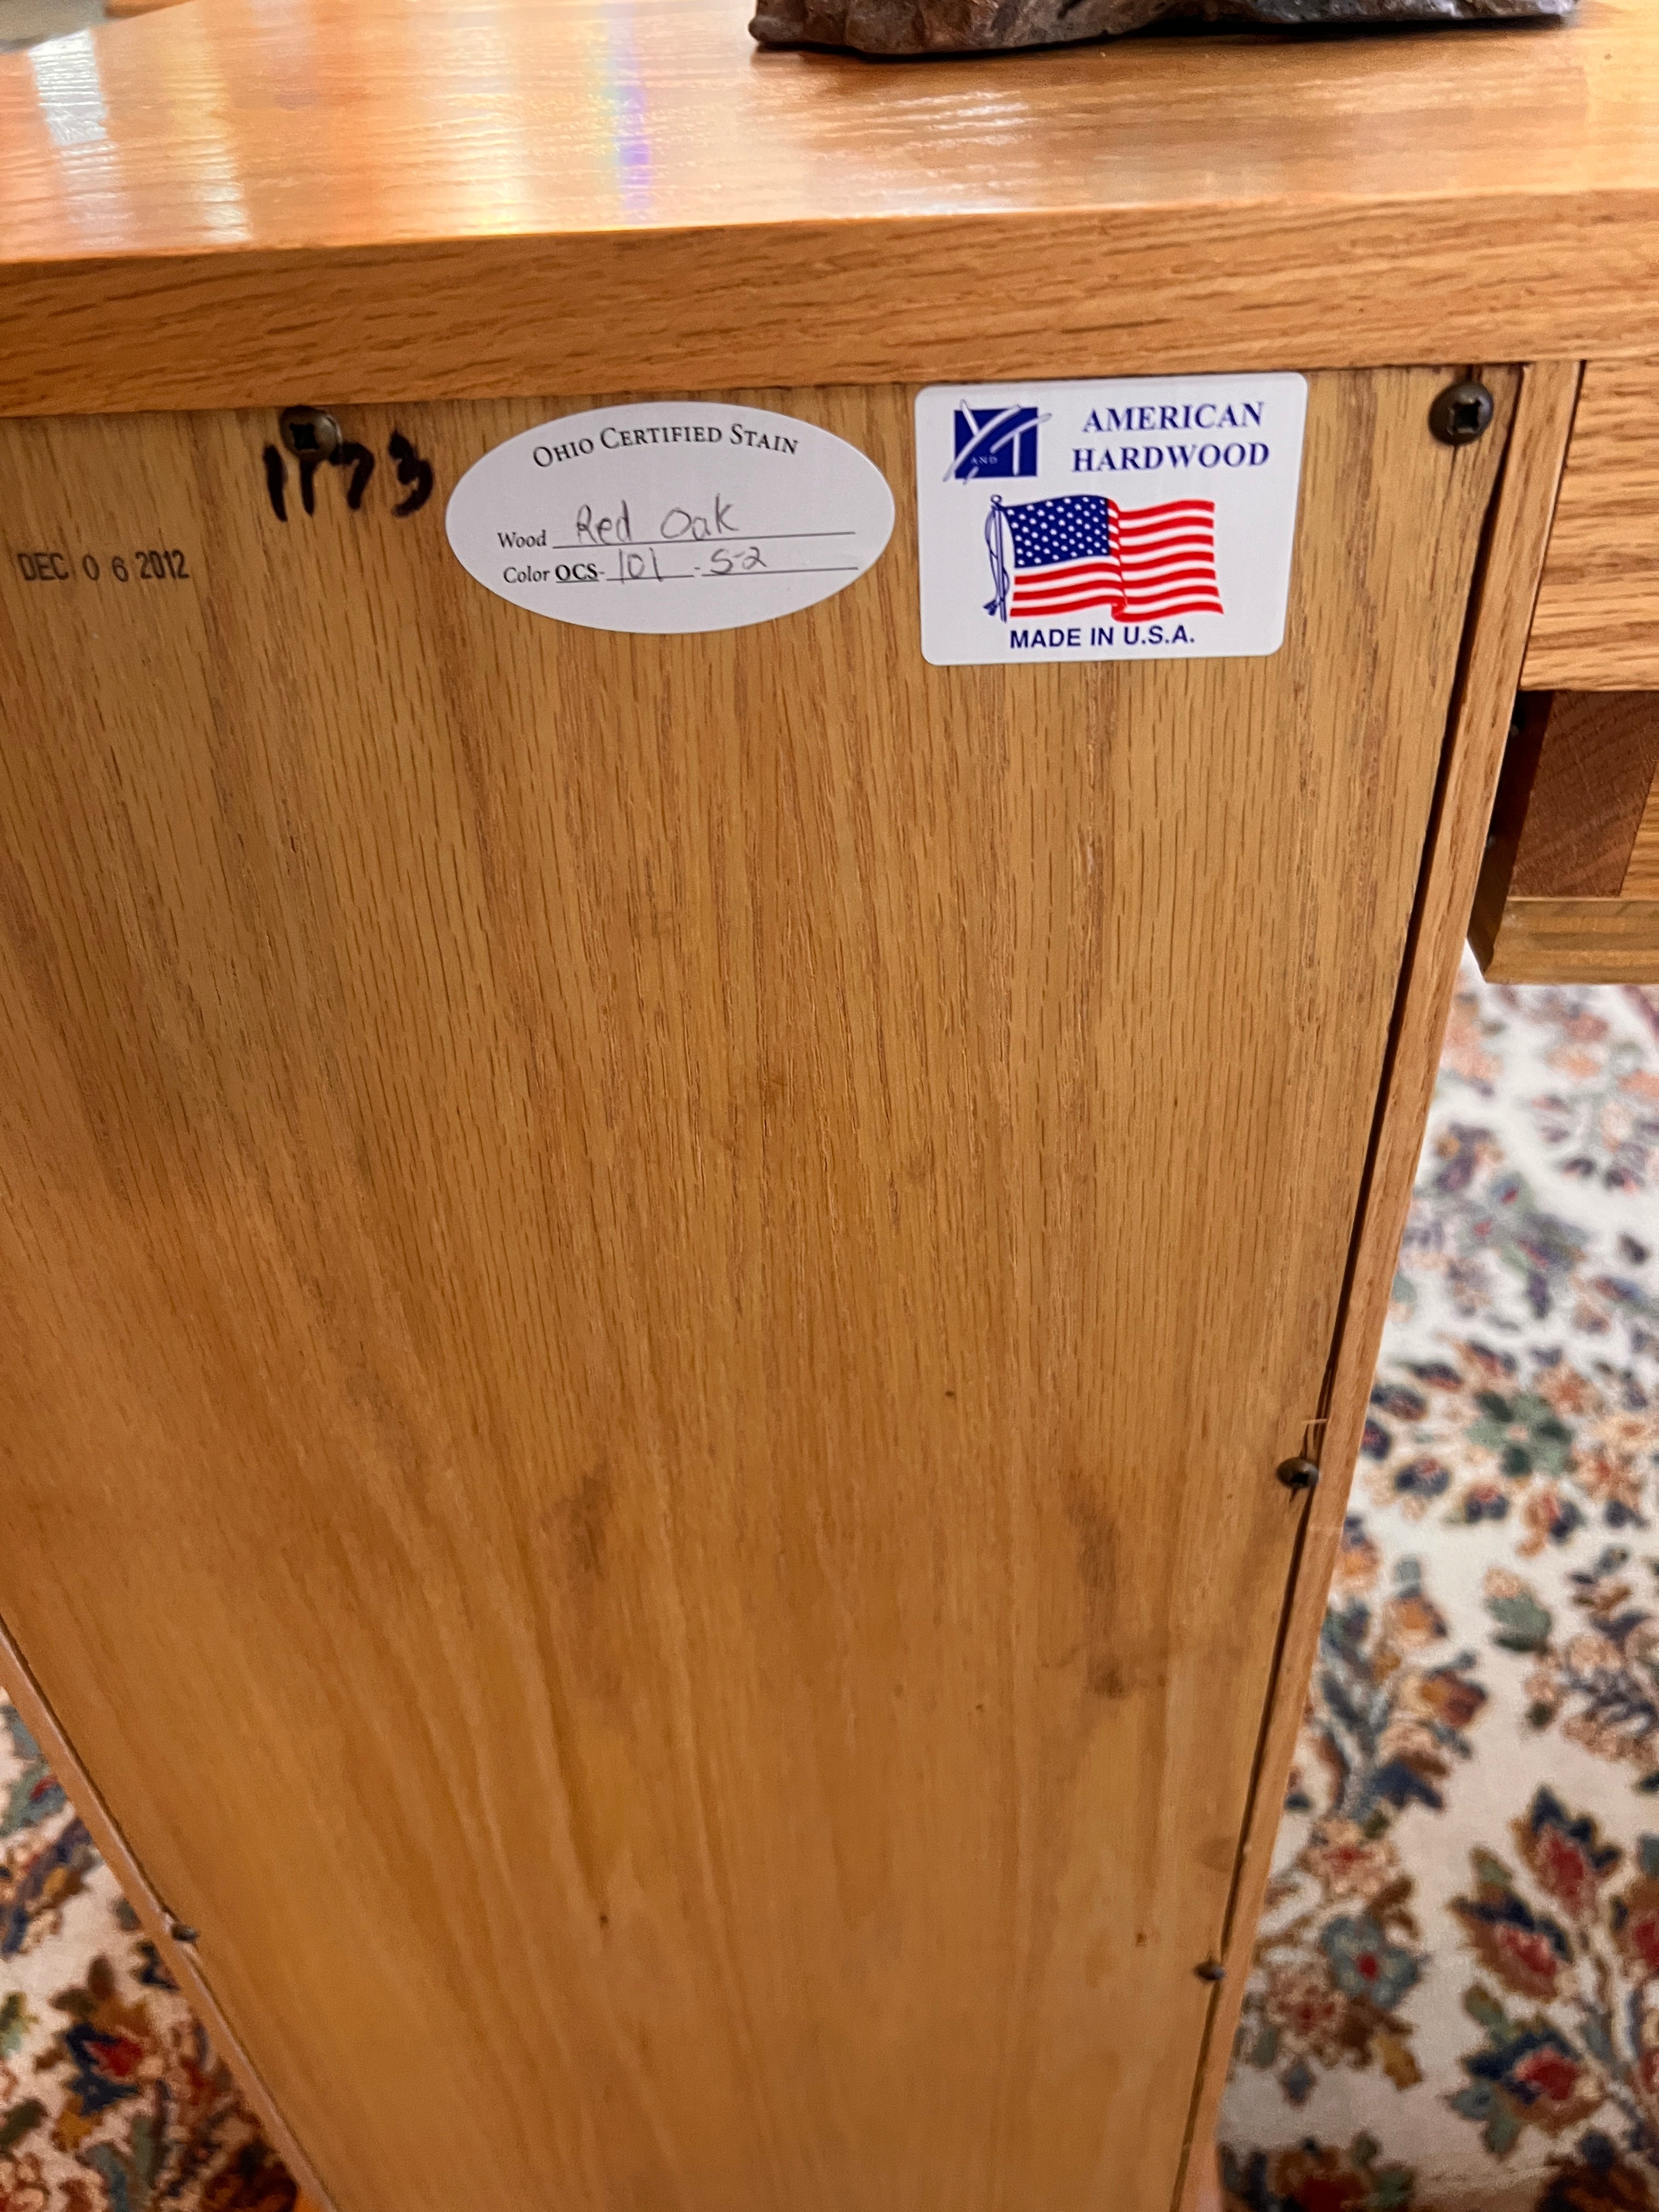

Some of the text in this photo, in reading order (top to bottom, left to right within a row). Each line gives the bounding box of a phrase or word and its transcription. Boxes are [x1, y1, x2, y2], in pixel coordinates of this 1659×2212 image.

[1083, 401, 1265, 433] AMERICAN
[533, 424, 799, 467] OHIO CERTIFIED STAIN
[1071, 442, 1269, 472] HARDWOOD
[497, 493, 739, 548] Wood Red Oak
[18, 552, 69, 582] DEC
[135, 549, 189, 580] 2012
[503, 565, 550, 583] Color
[618, 547, 663, 584] 101
[1009, 625, 1195, 649] MADE IN U.S.A.
